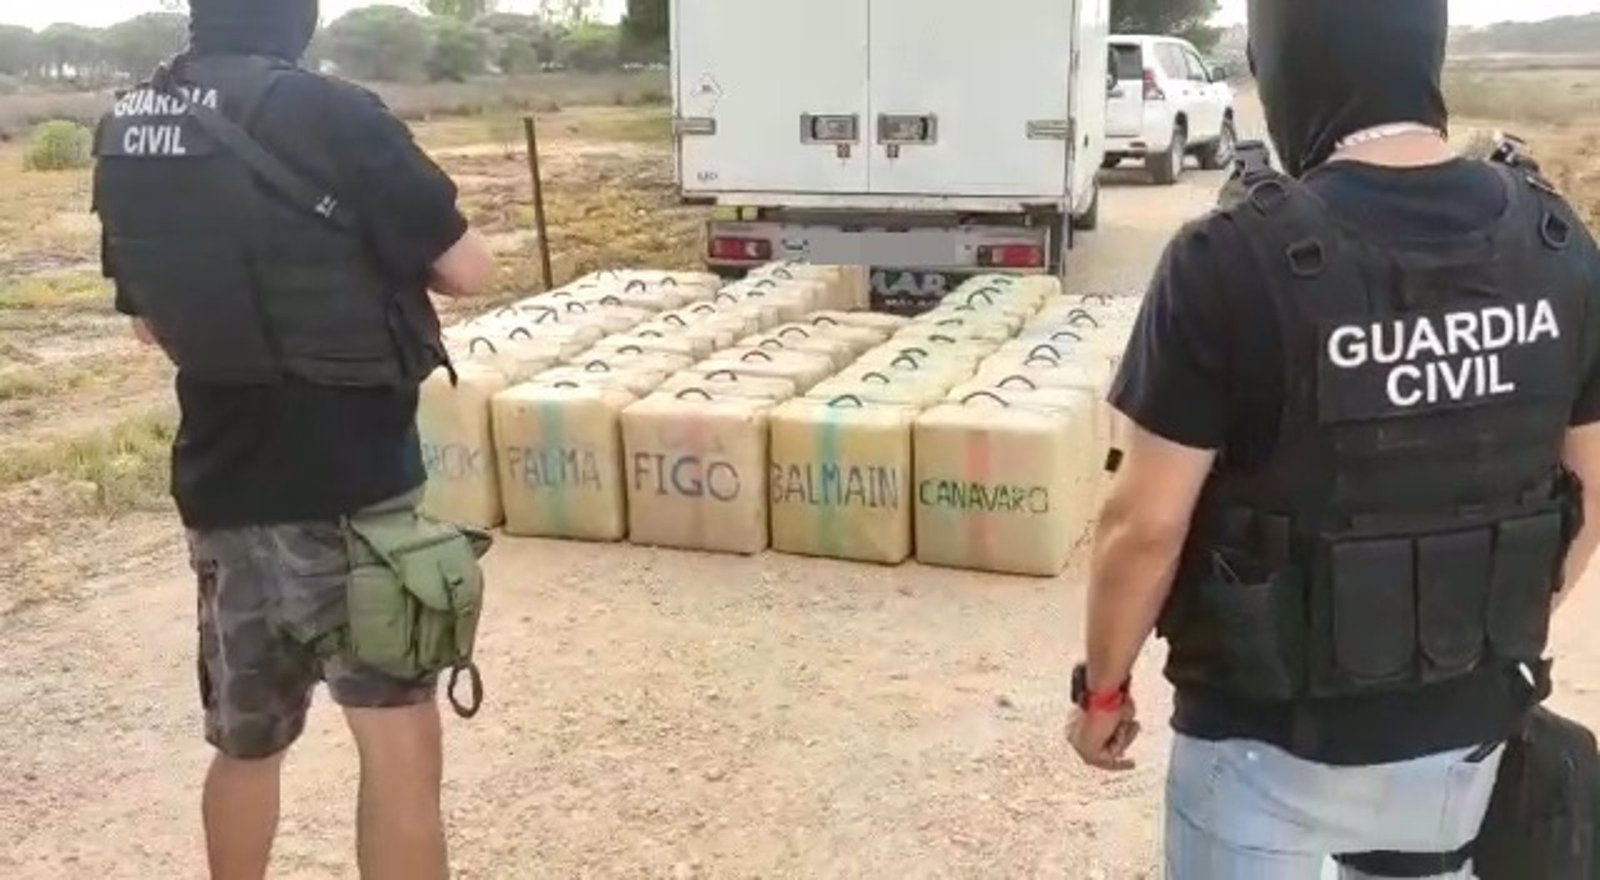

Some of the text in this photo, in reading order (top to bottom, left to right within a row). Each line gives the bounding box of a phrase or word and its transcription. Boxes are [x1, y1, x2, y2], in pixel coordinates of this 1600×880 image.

[123, 125, 186, 155] CIVIL
[1327, 298, 1560, 368] GUARDIA
[1386, 353, 1515, 407] CIVIL
[506, 445, 602, 490] PALMA
[633, 451, 740, 502] FIGO
[769, 461, 898, 510] BALMAIN
